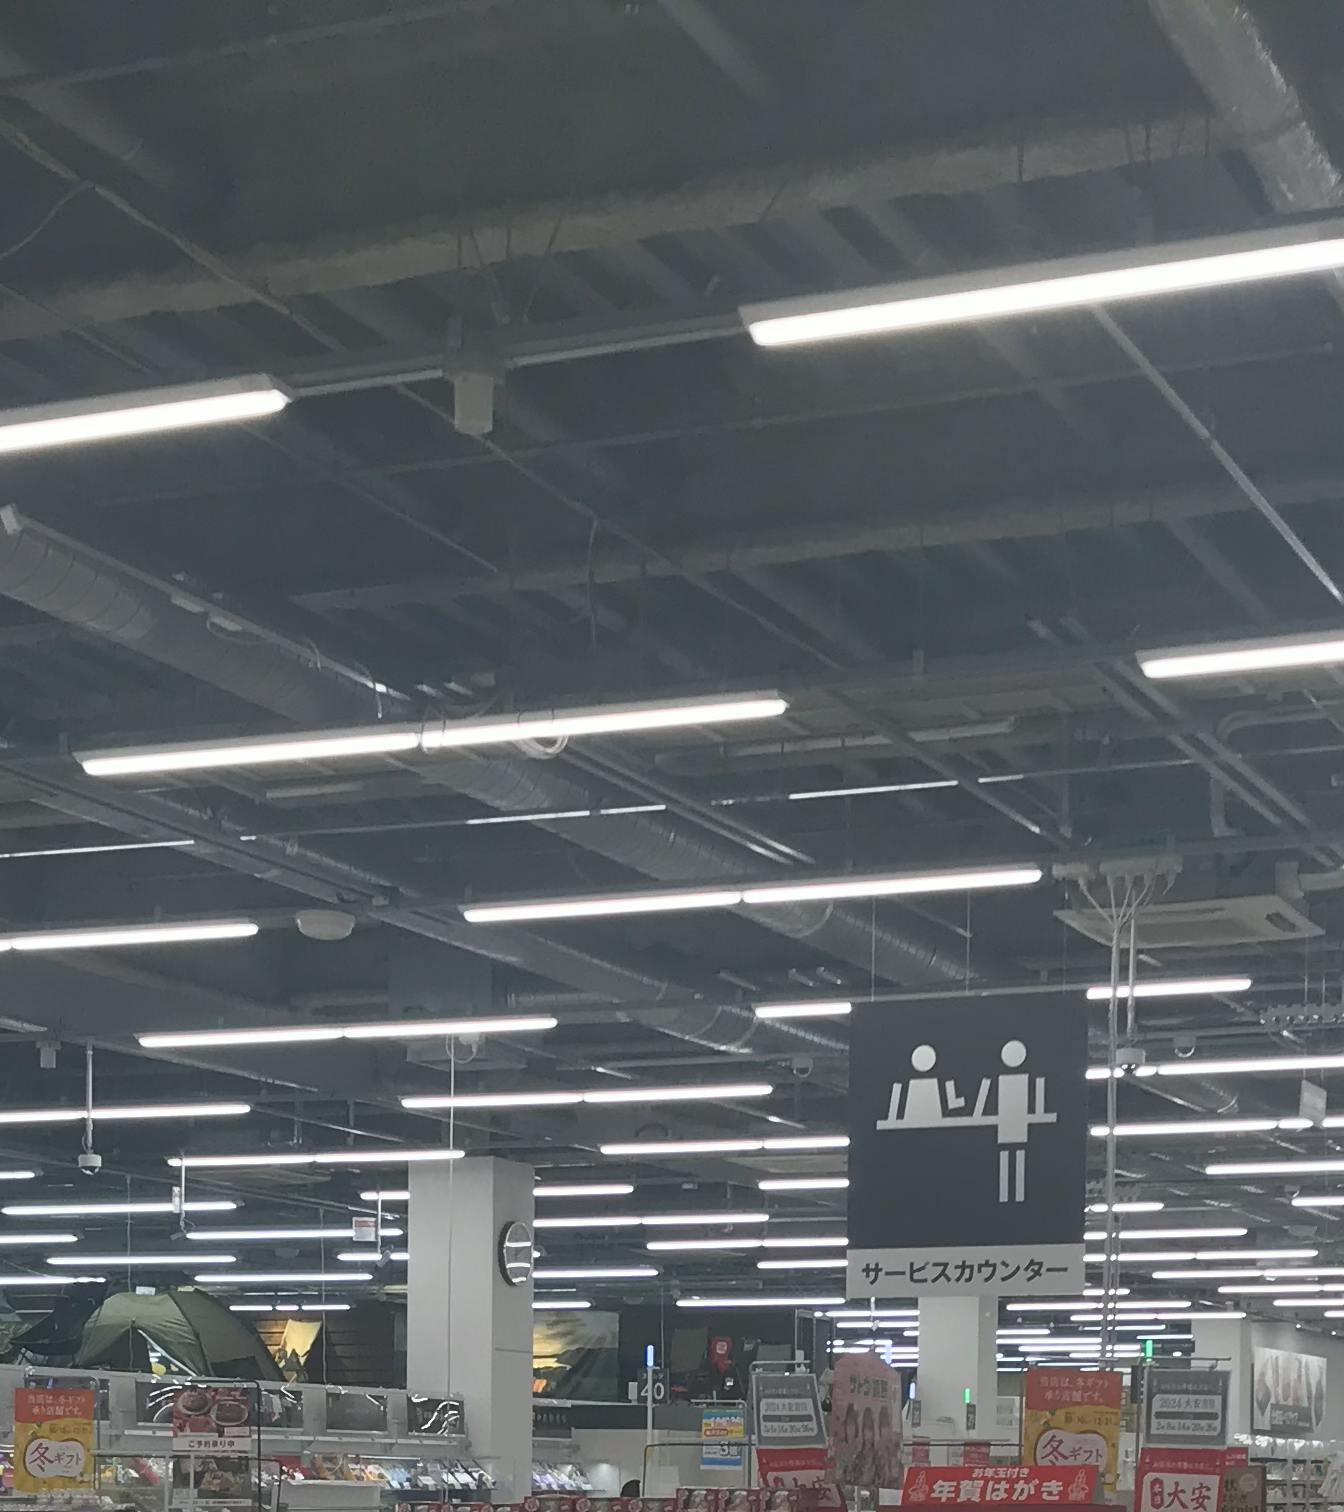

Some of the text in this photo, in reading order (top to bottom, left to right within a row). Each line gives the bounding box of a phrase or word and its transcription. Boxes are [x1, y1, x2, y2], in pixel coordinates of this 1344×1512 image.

[862, 1259, 1068, 1285] サービスカウンター
[641, 1382, 664, 1400] 40
[29, 1442, 81, 1472] 冬ギフト
[1041, 1434, 1103, 1465] 冬ギフト
[972, 1468, 1029, 1478] お年玉付き
[930, 1479, 1063, 1502] 年賀はがき
[1164, 1481, 1212, 1512] 大安
